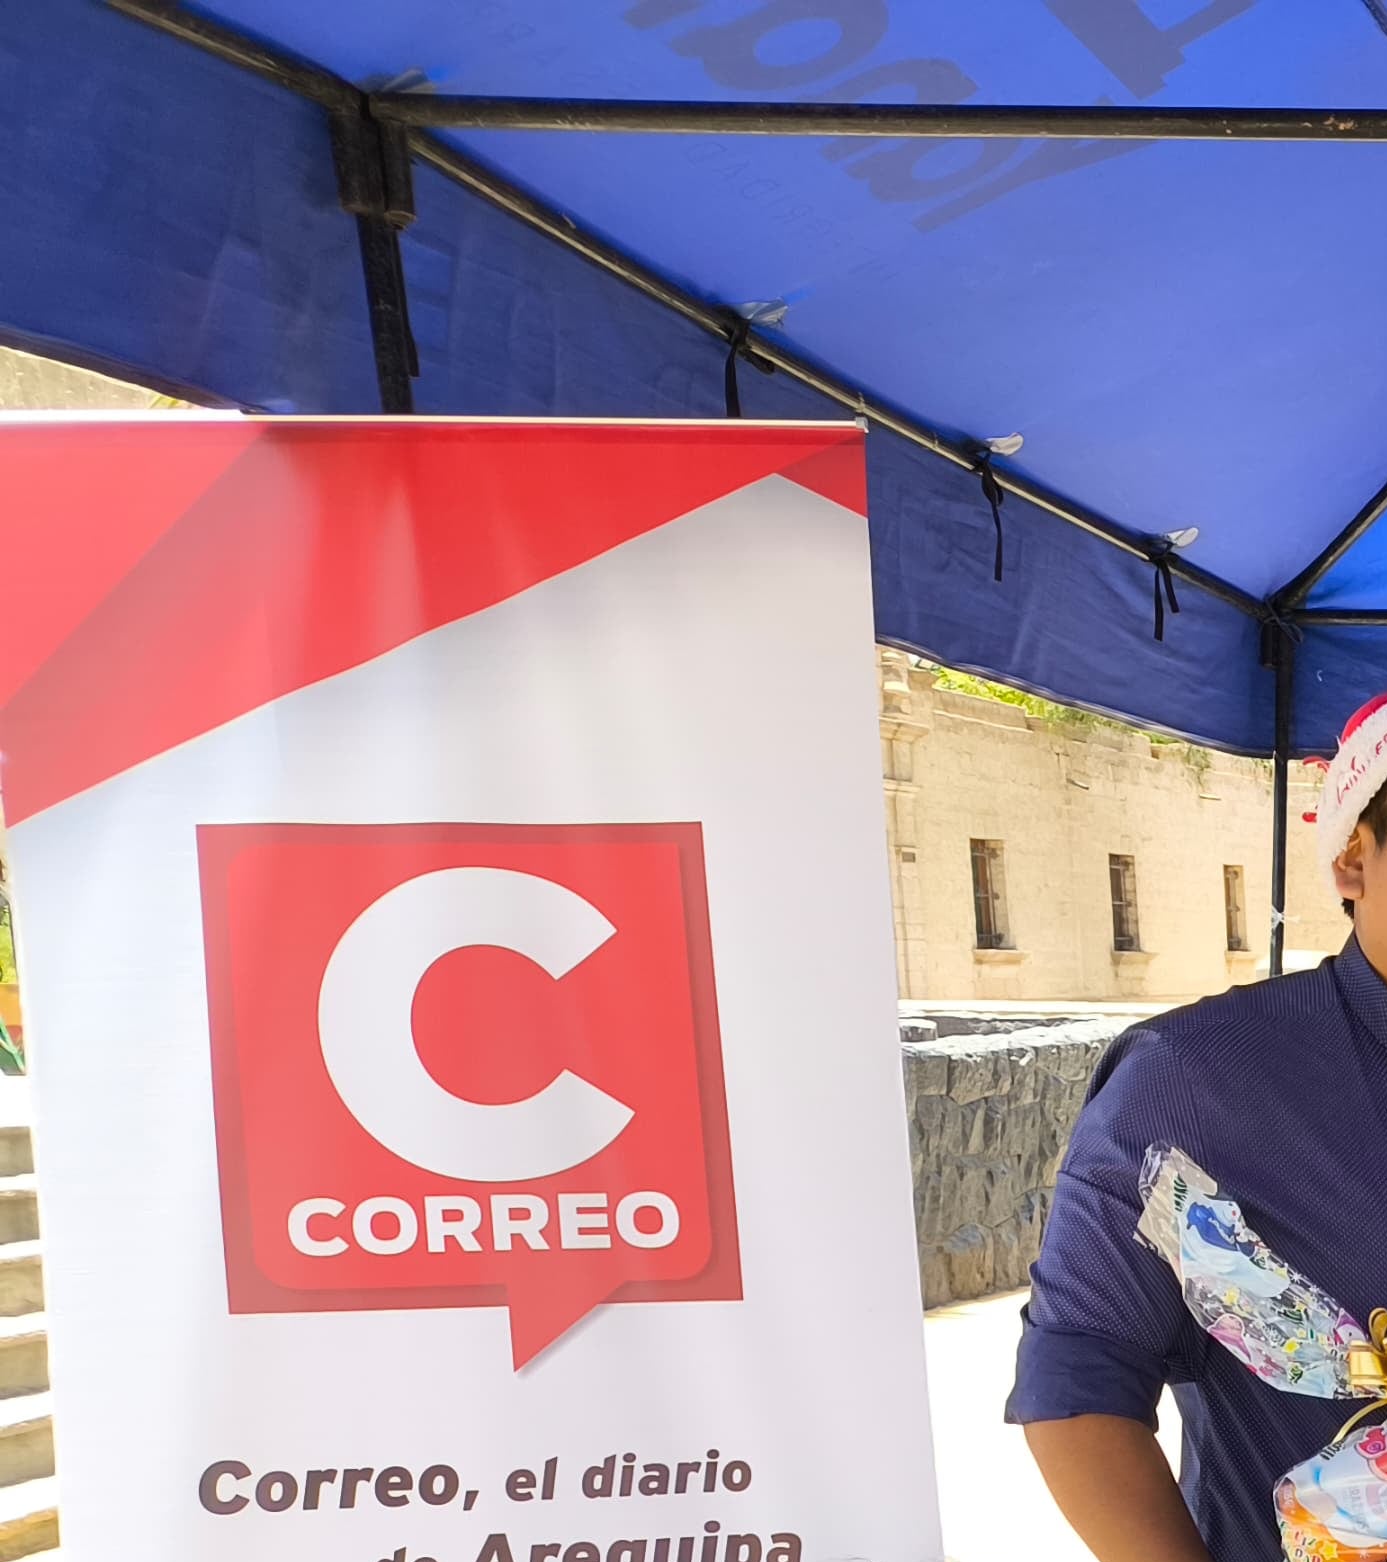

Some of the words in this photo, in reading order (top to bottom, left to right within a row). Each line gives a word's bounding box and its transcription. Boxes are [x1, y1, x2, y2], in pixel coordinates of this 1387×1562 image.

[318, 866, 636, 1183] C
[287, 1190, 680, 1257] CORREO
[198, 1457, 479, 1516] Correo,
[504, 1456, 559, 1502] el
[581, 1449, 753, 1500] diario
